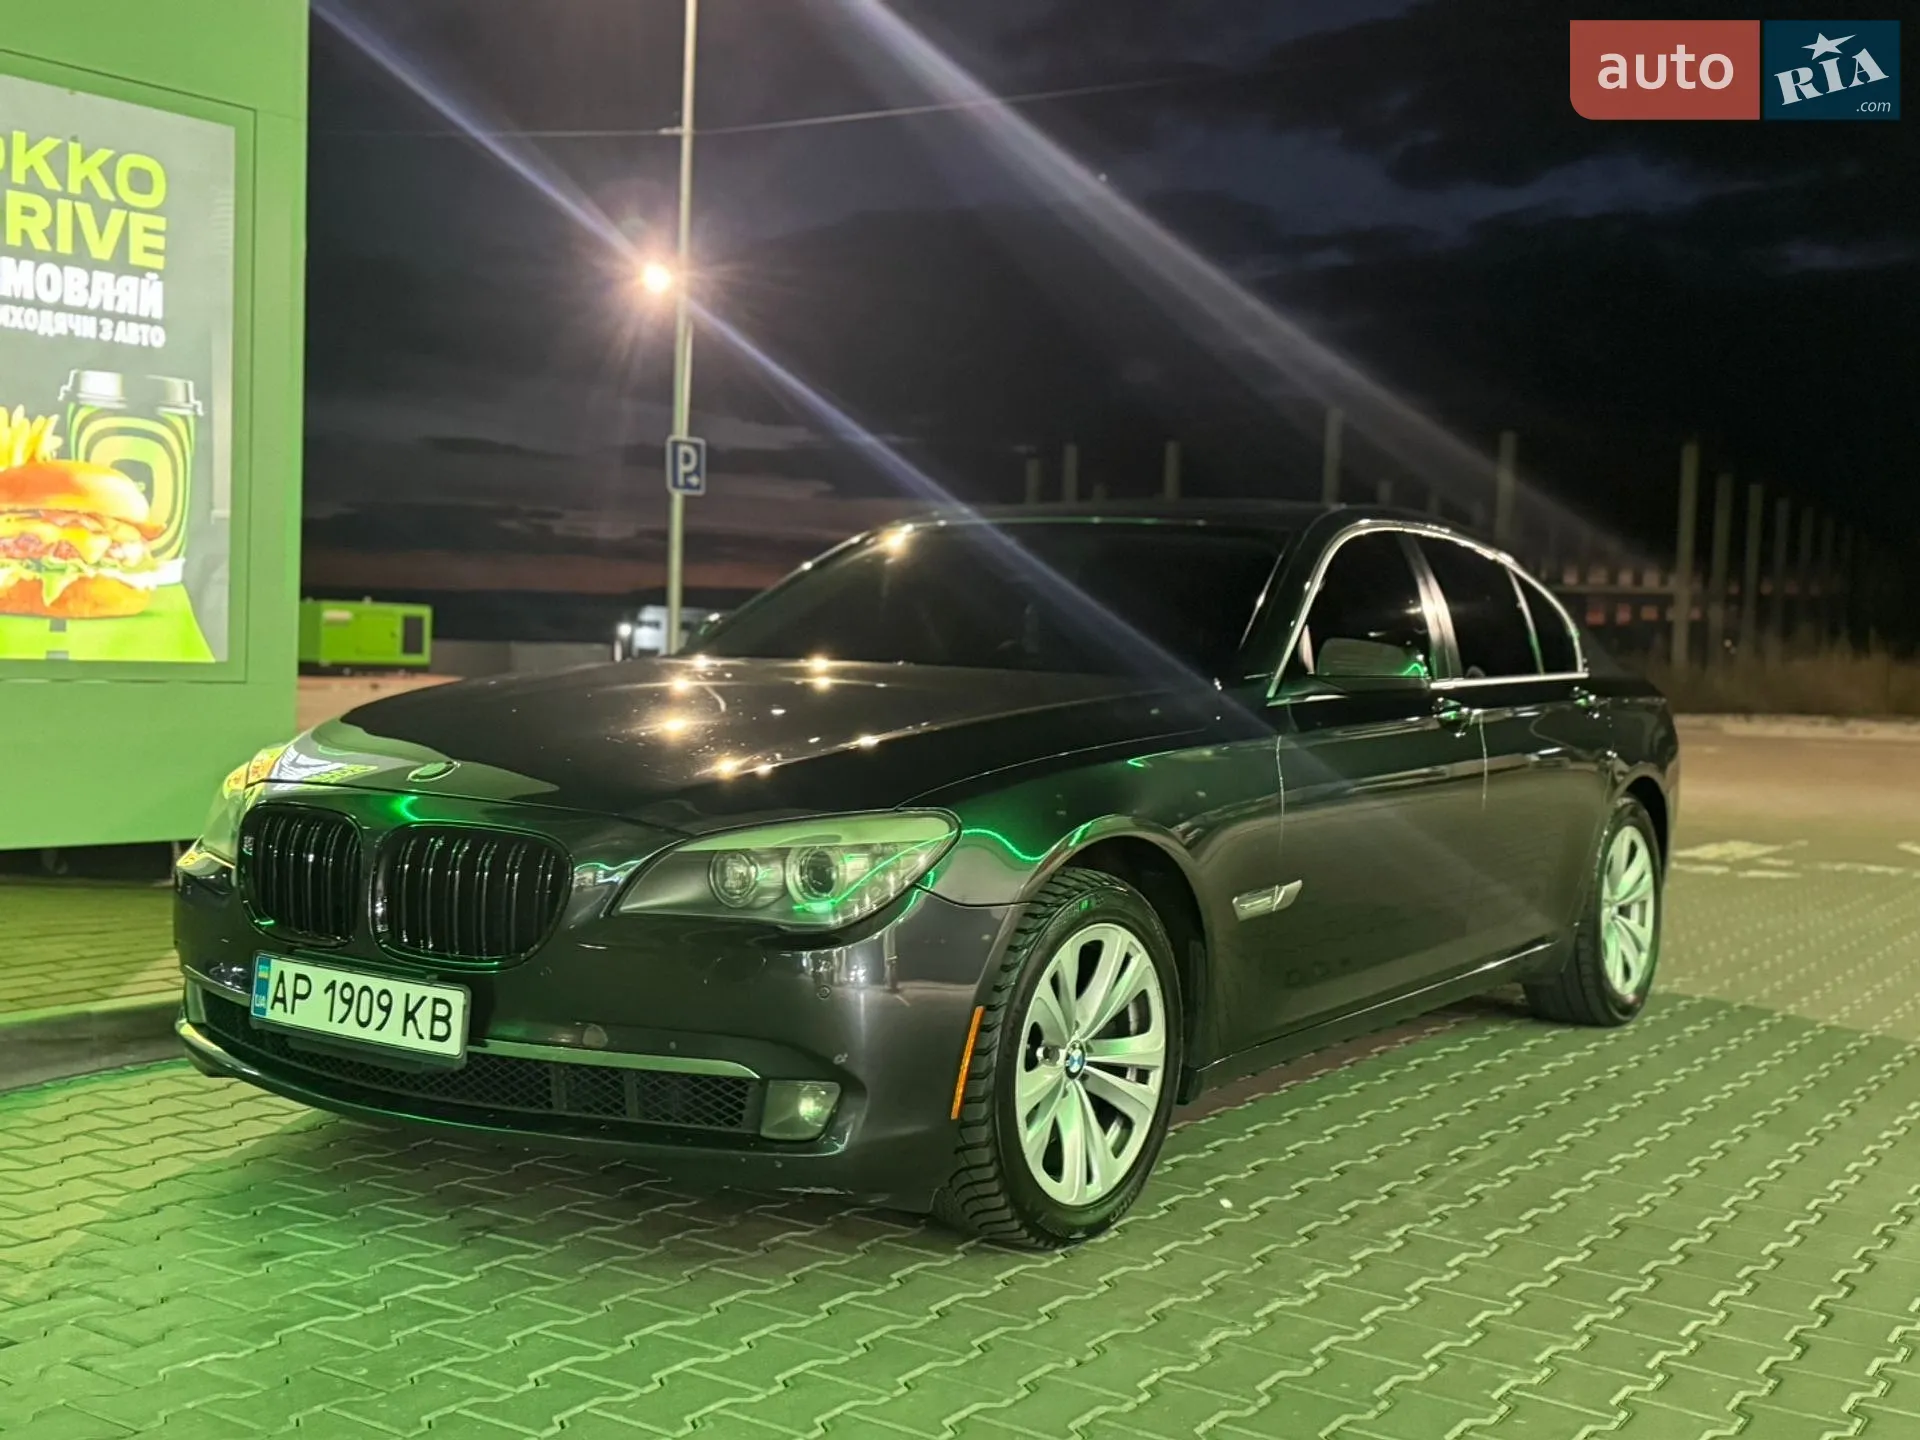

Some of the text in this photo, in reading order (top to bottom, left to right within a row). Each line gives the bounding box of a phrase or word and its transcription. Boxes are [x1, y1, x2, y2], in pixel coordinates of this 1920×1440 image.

[0, 130, 167, 209] KKO
[114, 321, 166, 348] АВТО
[677, 443, 698, 487] P
[270, 969, 453, 1043] AP 1909 KB
